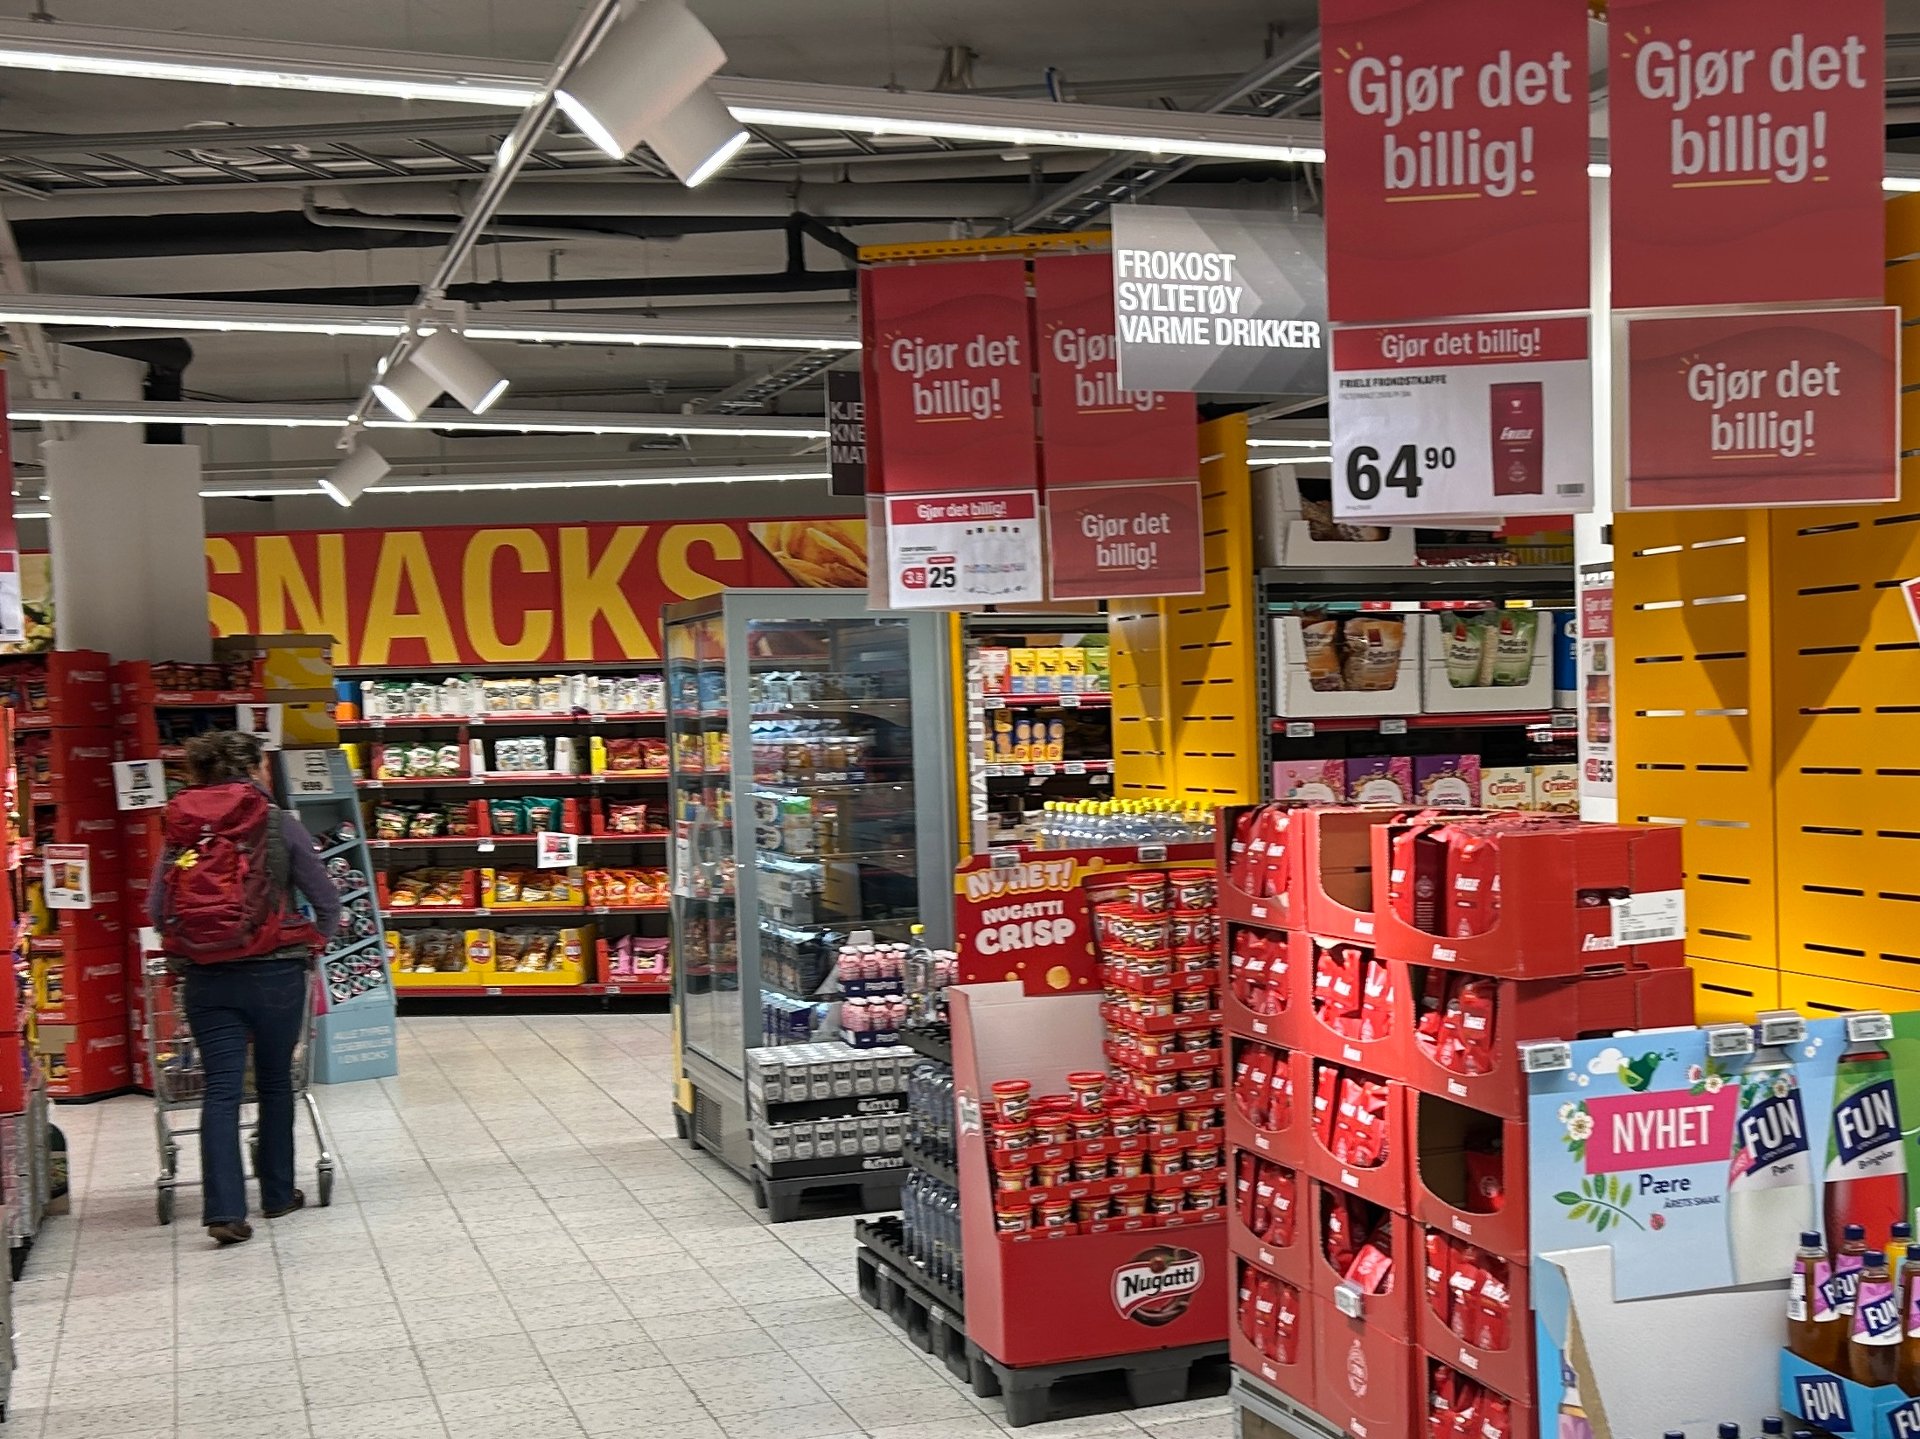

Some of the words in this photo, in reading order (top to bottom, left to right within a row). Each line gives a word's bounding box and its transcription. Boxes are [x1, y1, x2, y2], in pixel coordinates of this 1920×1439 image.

[1349, 54, 1462, 127] Gjør
[1478, 50, 1571, 107] det
[1636, 38, 1754, 110] Gjør
[1770, 34, 1866, 91] det
[1384, 126, 1535, 198] billig!
[1671, 111, 1828, 183] billig!
[1118, 250, 1236, 282] FROKOST
[1118, 283, 1242, 315] SYLTETØY
[1118, 315, 1210, 345] VARME
[1215, 319, 1321, 348] DRIKKER
[1381, 333, 1429, 363] Gjør
[1434, 332, 1473, 355] det
[1478, 327, 1541, 357] billig!
[890, 338, 958, 377] Gjør
[965, 334, 1020, 369] det
[913, 378, 1002, 420] billig!
[1687, 361, 1767, 409] Gjør
[1776, 359, 1840, 398] det
[831, 402, 865, 420] KJE
[831, 423, 866, 442] KNE
[1710, 411, 1815, 456] billig!
[832, 445, 867, 464] MAT
[1346, 444, 1423, 501] 64
[1425, 447, 1456, 469] 90
[946, 502, 969, 517] det
[1081, 513, 1127, 542] Gjør
[1131, 511, 1170, 535] det
[1097, 542, 1158, 571] billig!
[205, 523, 743, 666] SNACKS
[929, 566, 956, 588] 25
[967, 861, 1073, 899] NYHET!
[981, 900, 1064, 925] NUGATTI
[975, 918, 1076, 955] CRISP
[1611, 1104, 1714, 1154] NYHET
[1742, 1099, 1802, 1158] FUN
[1837, 1089, 1896, 1149] FUN
[1639, 1173, 1691, 1196] Pære
[1122, 1266, 1195, 1297] Nugatti
[1864, 1297, 1899, 1330] FUN
[1801, 1381, 1846, 1420] FUN
[1894, 1402, 1920, 1439] FU
